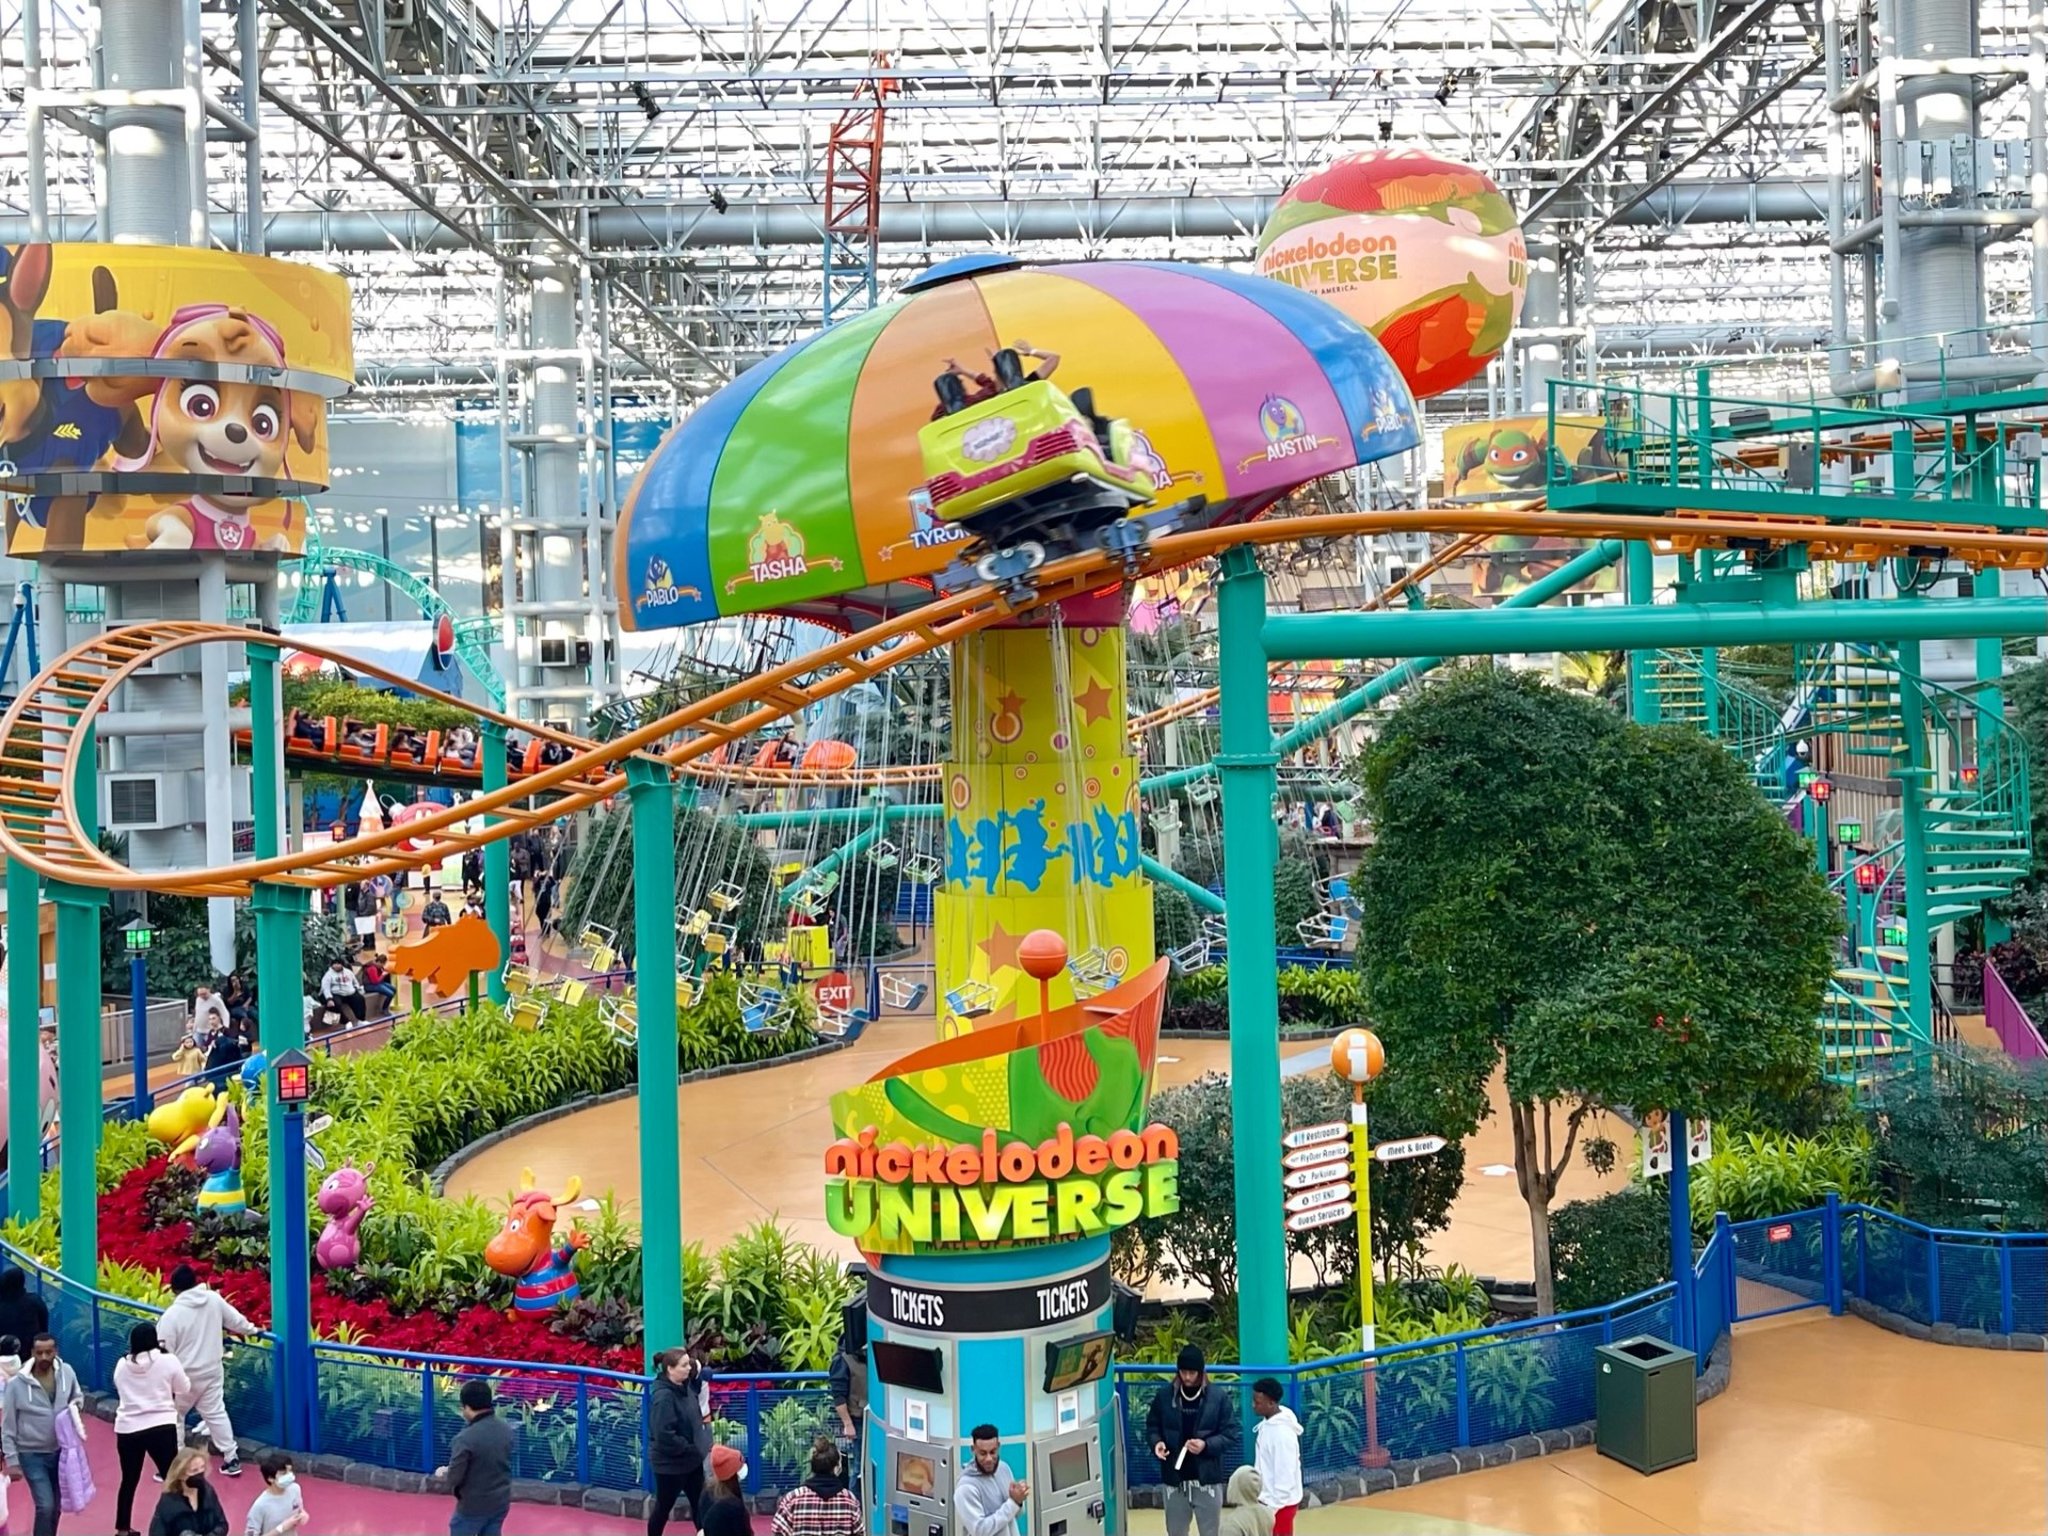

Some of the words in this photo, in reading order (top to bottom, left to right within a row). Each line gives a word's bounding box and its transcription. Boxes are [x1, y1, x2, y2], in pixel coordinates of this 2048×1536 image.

[1263, 232, 1397, 272] nickelodeon
[1264, 254, 1398, 288] NIVERSE
[1375, 413, 1403, 435] PABLO
[1266, 434, 1318, 461] AUSTIN
[910, 527, 972, 549] TYRON
[750, 556, 808, 583] TASHA
[645, 585, 679, 608] PABLO
[819, 985, 852, 1001] EXIT
[1306, 1127, 1340, 1141] Restrooms
[825, 1121, 1181, 1186] nickelodeon
[825, 1159, 1182, 1242] UNIVERSE
[1298, 1214, 1316, 1226] Guest
[1318, 1207, 1345, 1221] Services
[1010, 1229, 1088, 1249] AMERICA
[890, 1286, 945, 1326] TICKETS
[1036, 1278, 1089, 1321] TICKETS
